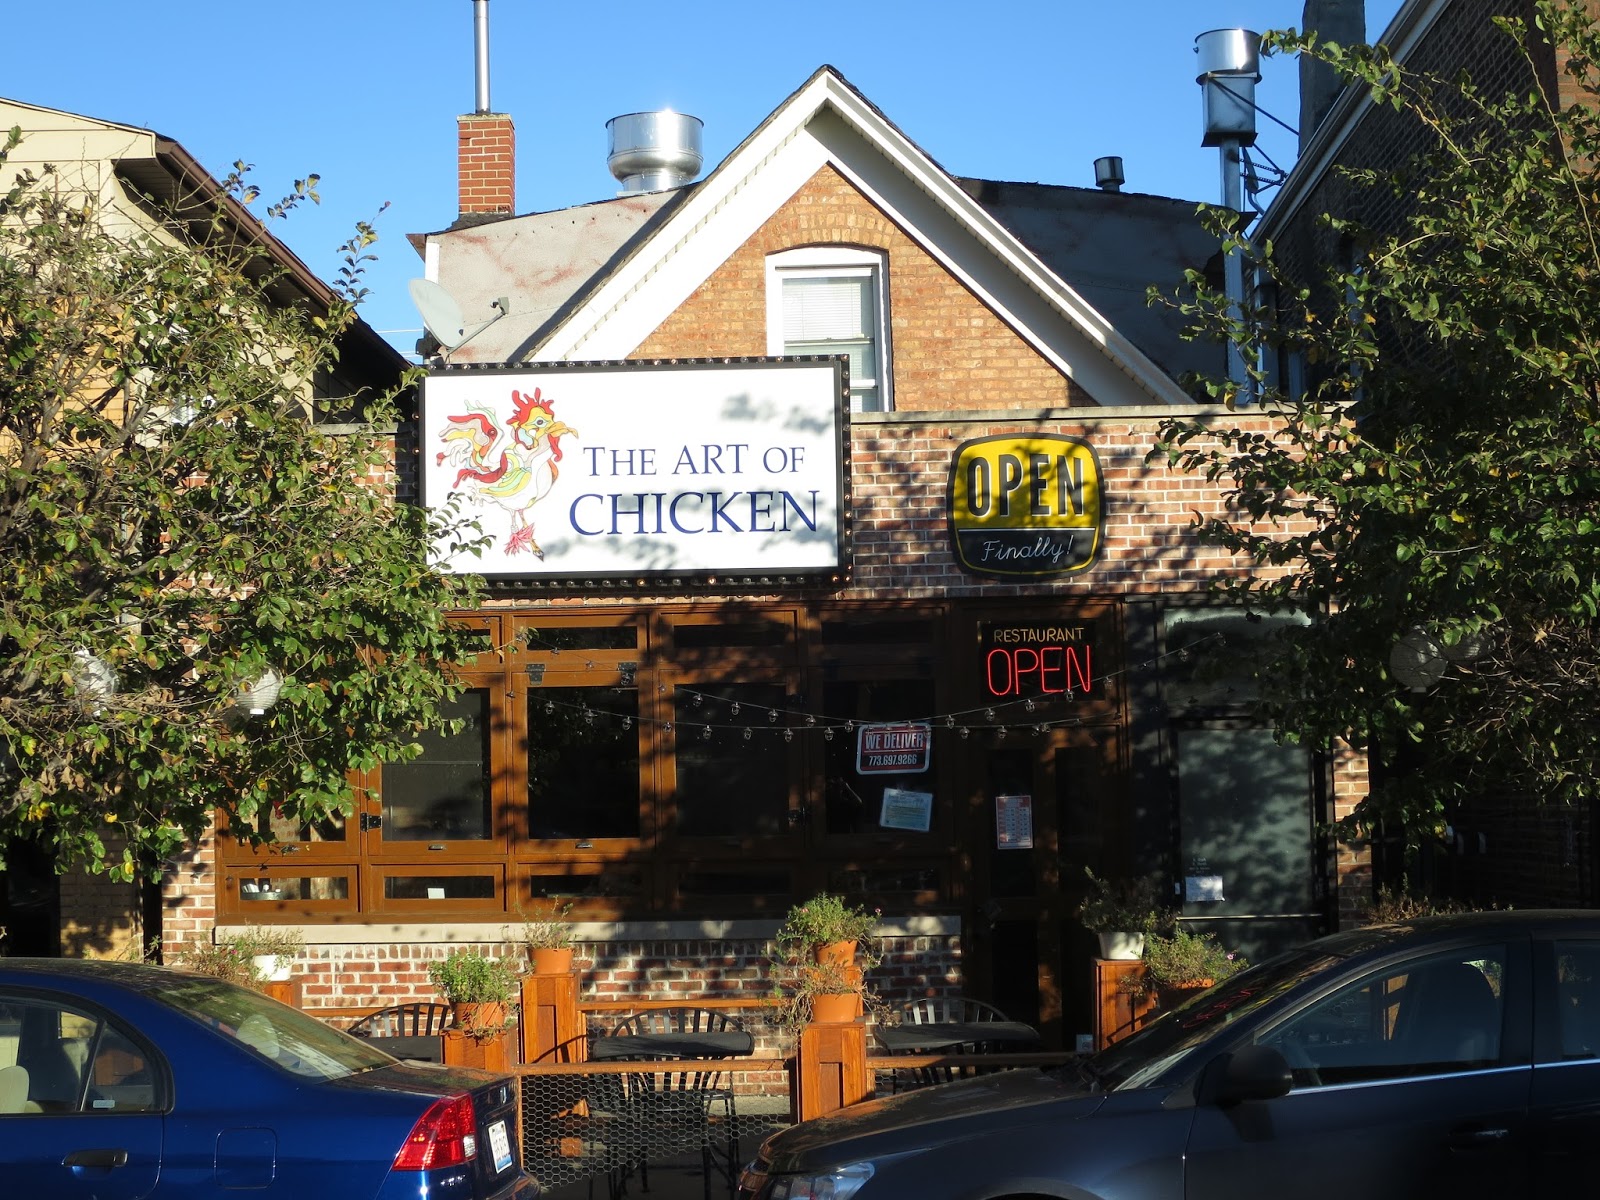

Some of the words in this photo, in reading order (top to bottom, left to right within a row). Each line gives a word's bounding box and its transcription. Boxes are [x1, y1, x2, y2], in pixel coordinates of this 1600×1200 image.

[583, 446, 657, 476] THE
[671, 443, 749, 475] ART
[763, 446, 805, 473] OF
[966, 453, 1085, 517] OPEN
[569, 489, 820, 536] CHICKEN
[981, 535, 1074, 564] Finally!
[993, 627, 1085, 643] RESTAURANT
[986, 645, 1091, 696] OPEN
[865, 733, 881, 750] WE
[883, 732, 924, 749] DELIVER
[868, 753, 918, 767] 773.697.9266
